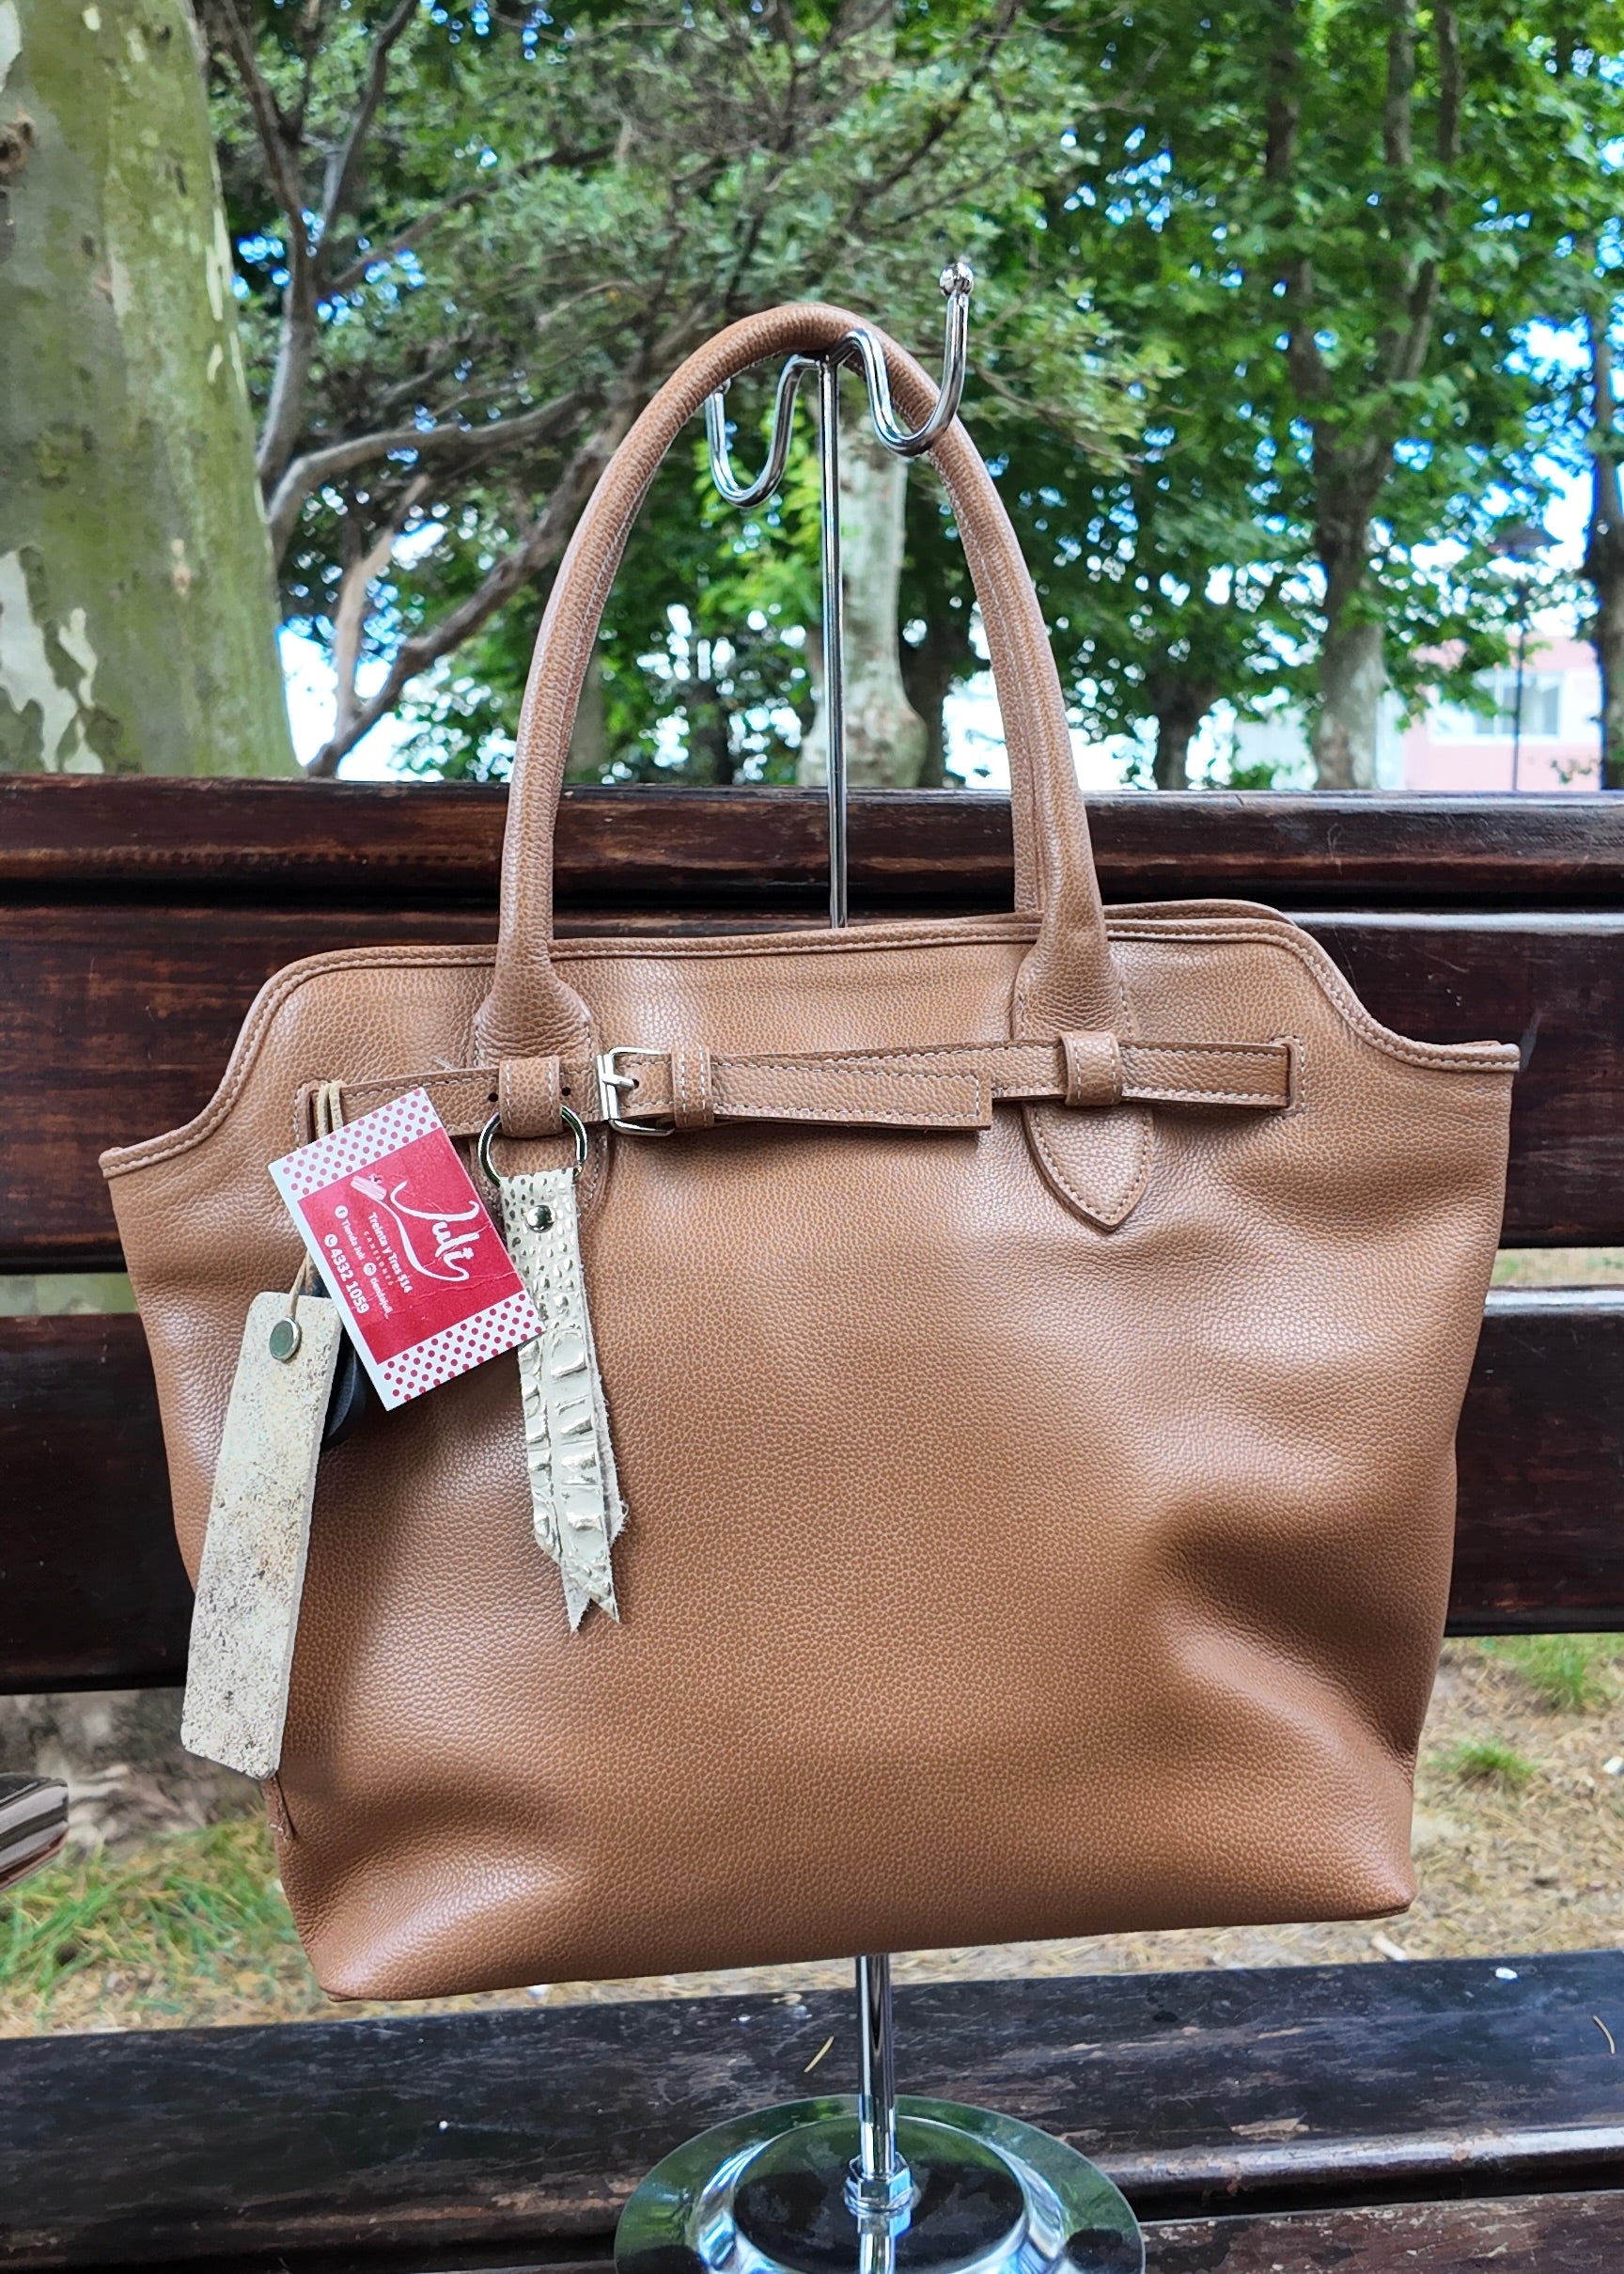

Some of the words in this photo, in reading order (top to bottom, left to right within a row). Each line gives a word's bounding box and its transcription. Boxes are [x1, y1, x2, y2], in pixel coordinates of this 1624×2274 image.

[341, 1218, 360, 1247] Tienda
[353, 1247, 366, 1262] Juli
[368, 1212, 388, 1247] Treinta
[387, 1252, 402, 1275] Tres
[398, 1275, 413, 1294] 514
[390, 1180, 480, 1281] Juli
[331, 1248, 354, 1282] 4332
[346, 1280, 369, 1314] 1059
